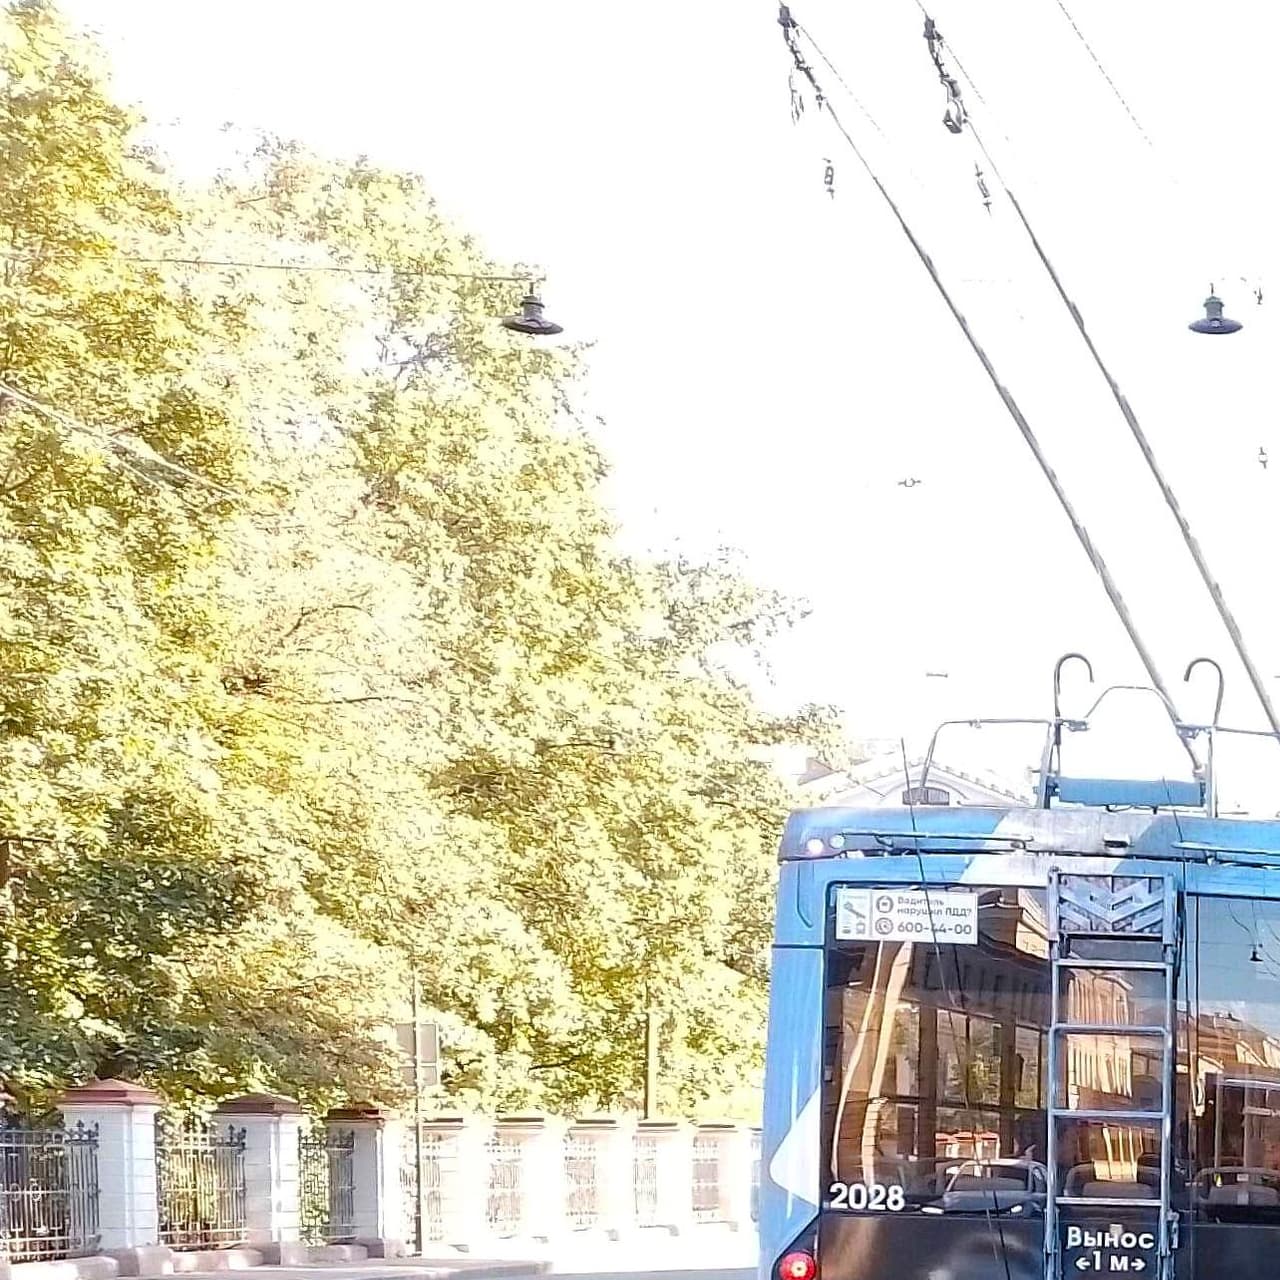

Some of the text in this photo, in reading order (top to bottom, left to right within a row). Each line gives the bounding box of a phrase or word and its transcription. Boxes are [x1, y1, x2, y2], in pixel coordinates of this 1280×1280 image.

[829, 1182, 906, 1212] 2028
[1066, 1225, 1155, 1250] Вынос
[1093, 1250, 1101, 1271] 1
